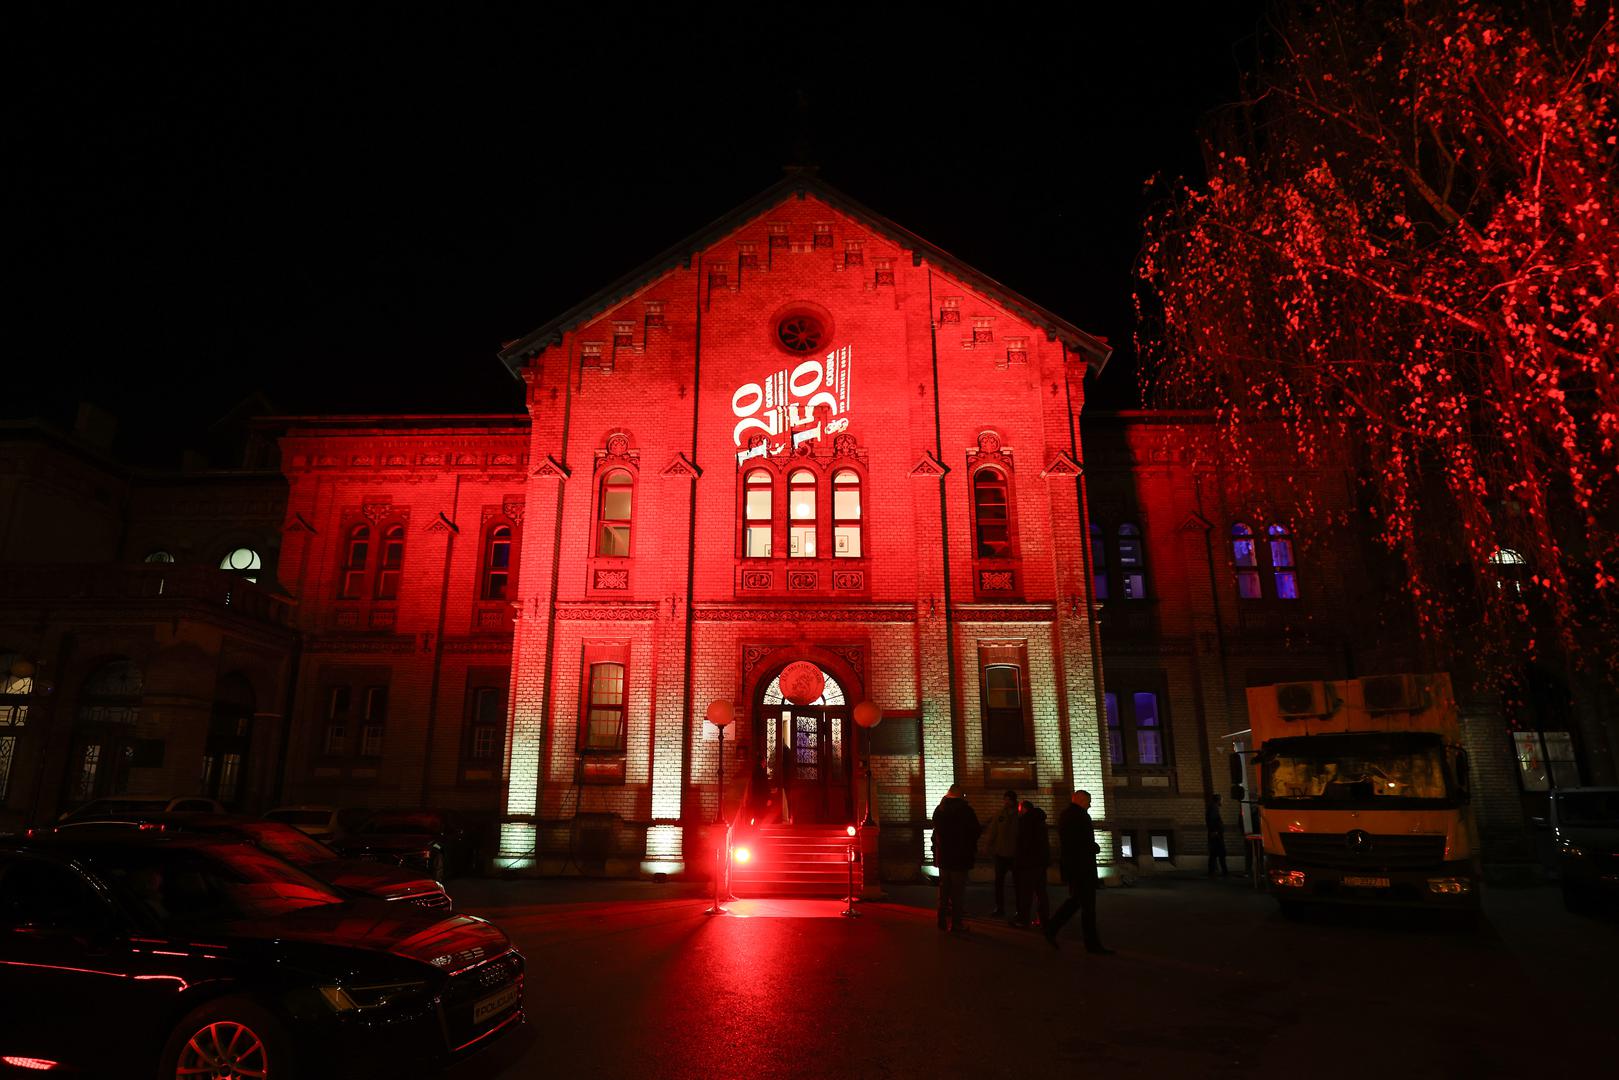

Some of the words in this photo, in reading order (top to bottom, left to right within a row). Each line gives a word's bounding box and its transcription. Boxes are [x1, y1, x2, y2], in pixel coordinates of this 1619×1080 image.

[790, 360, 837, 449] 150
[826, 351, 834, 387] GODINA
[732, 383, 777, 466] 120
